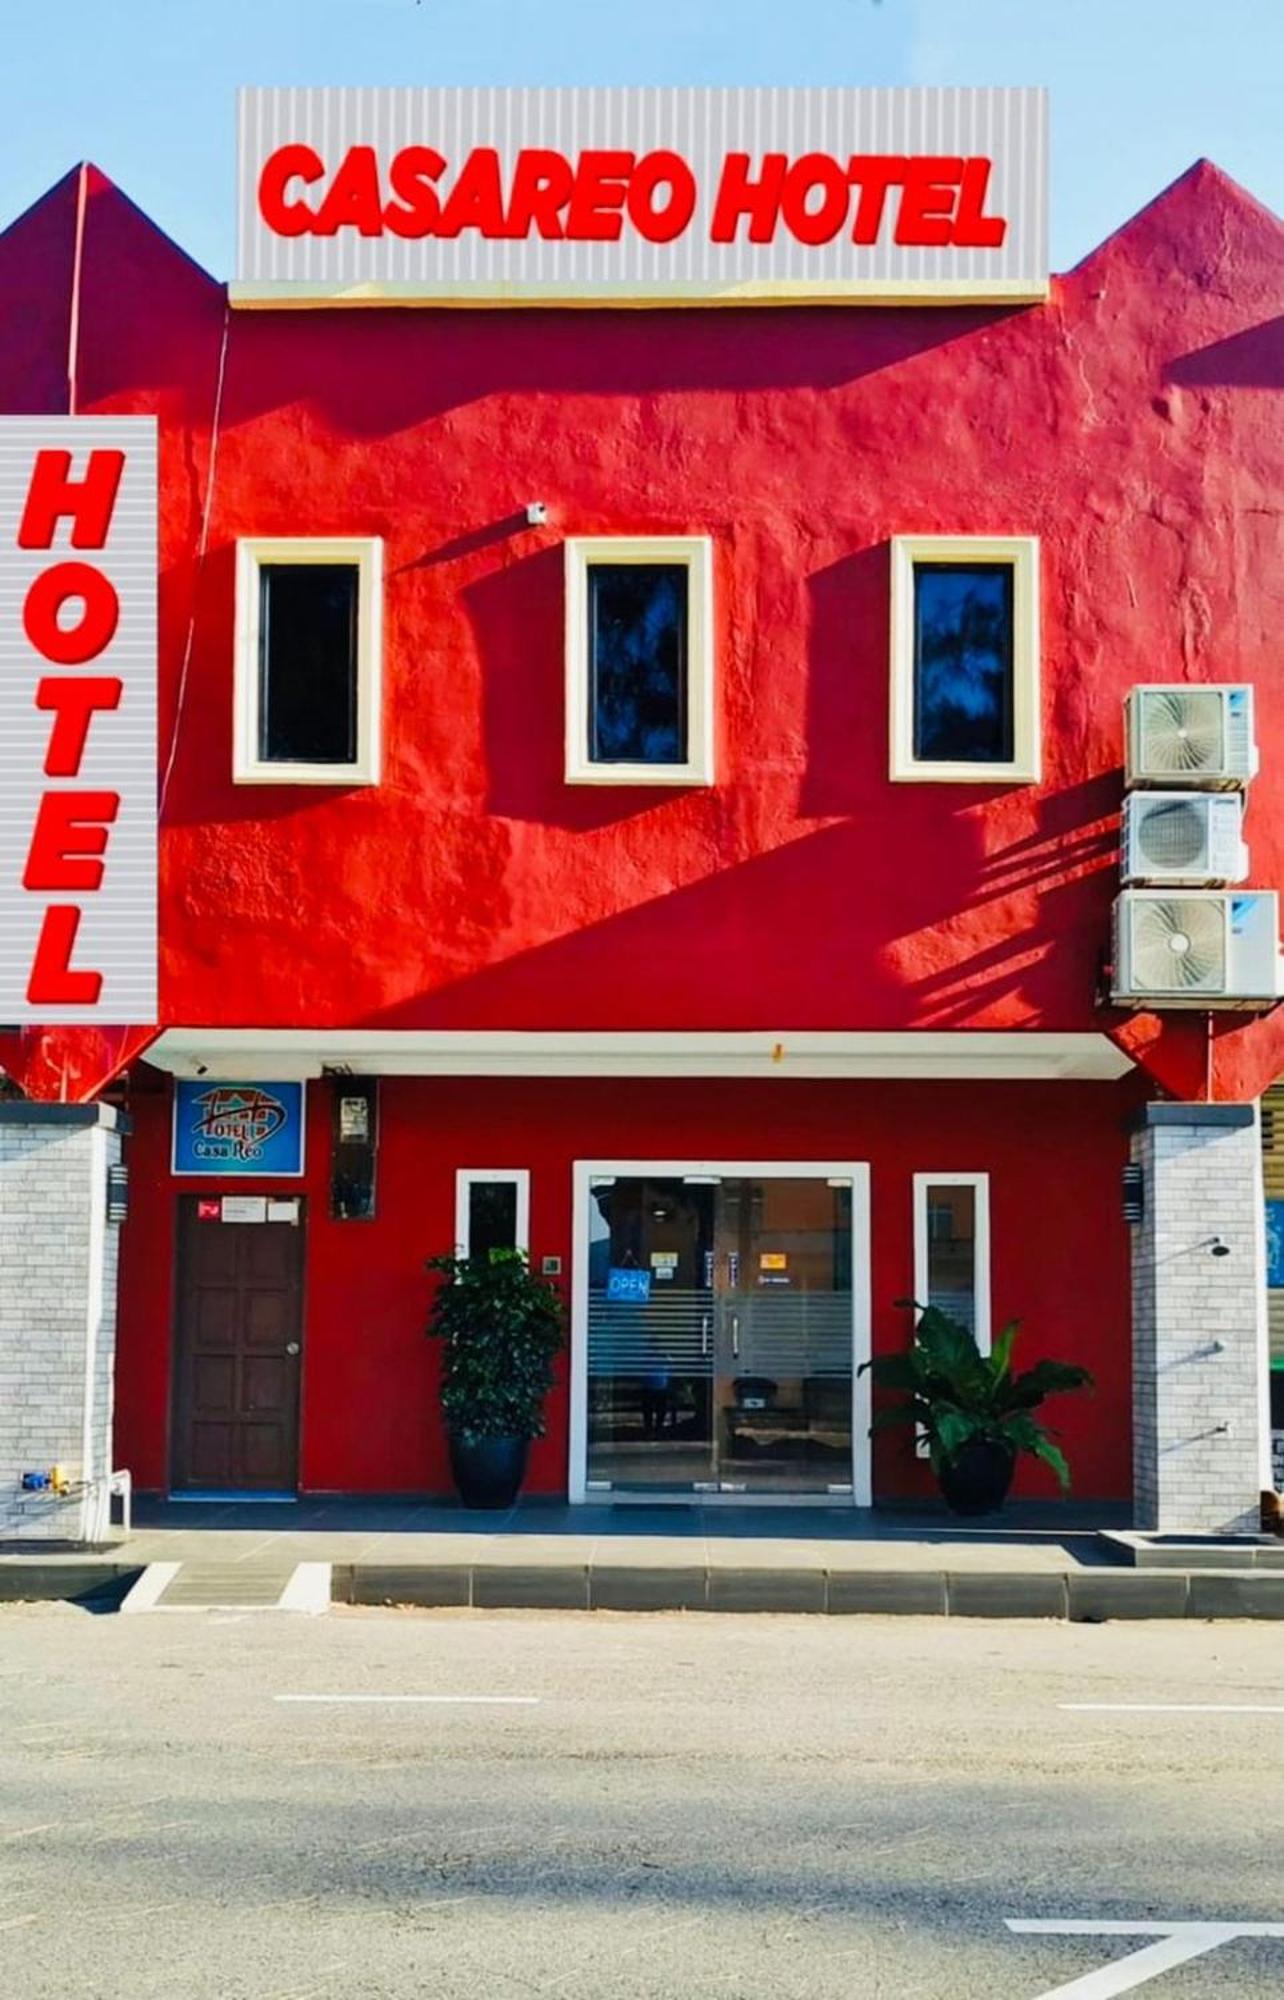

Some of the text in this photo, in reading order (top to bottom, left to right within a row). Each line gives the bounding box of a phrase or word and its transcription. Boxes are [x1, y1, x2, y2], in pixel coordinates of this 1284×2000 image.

[258, 143, 1006, 248] CASAREO HOTEL
[17, 450, 125, 1004] HOTEL
[193, 1140, 263, 1161] Casa Reo
[609, 1276, 649, 1296] OPEN
